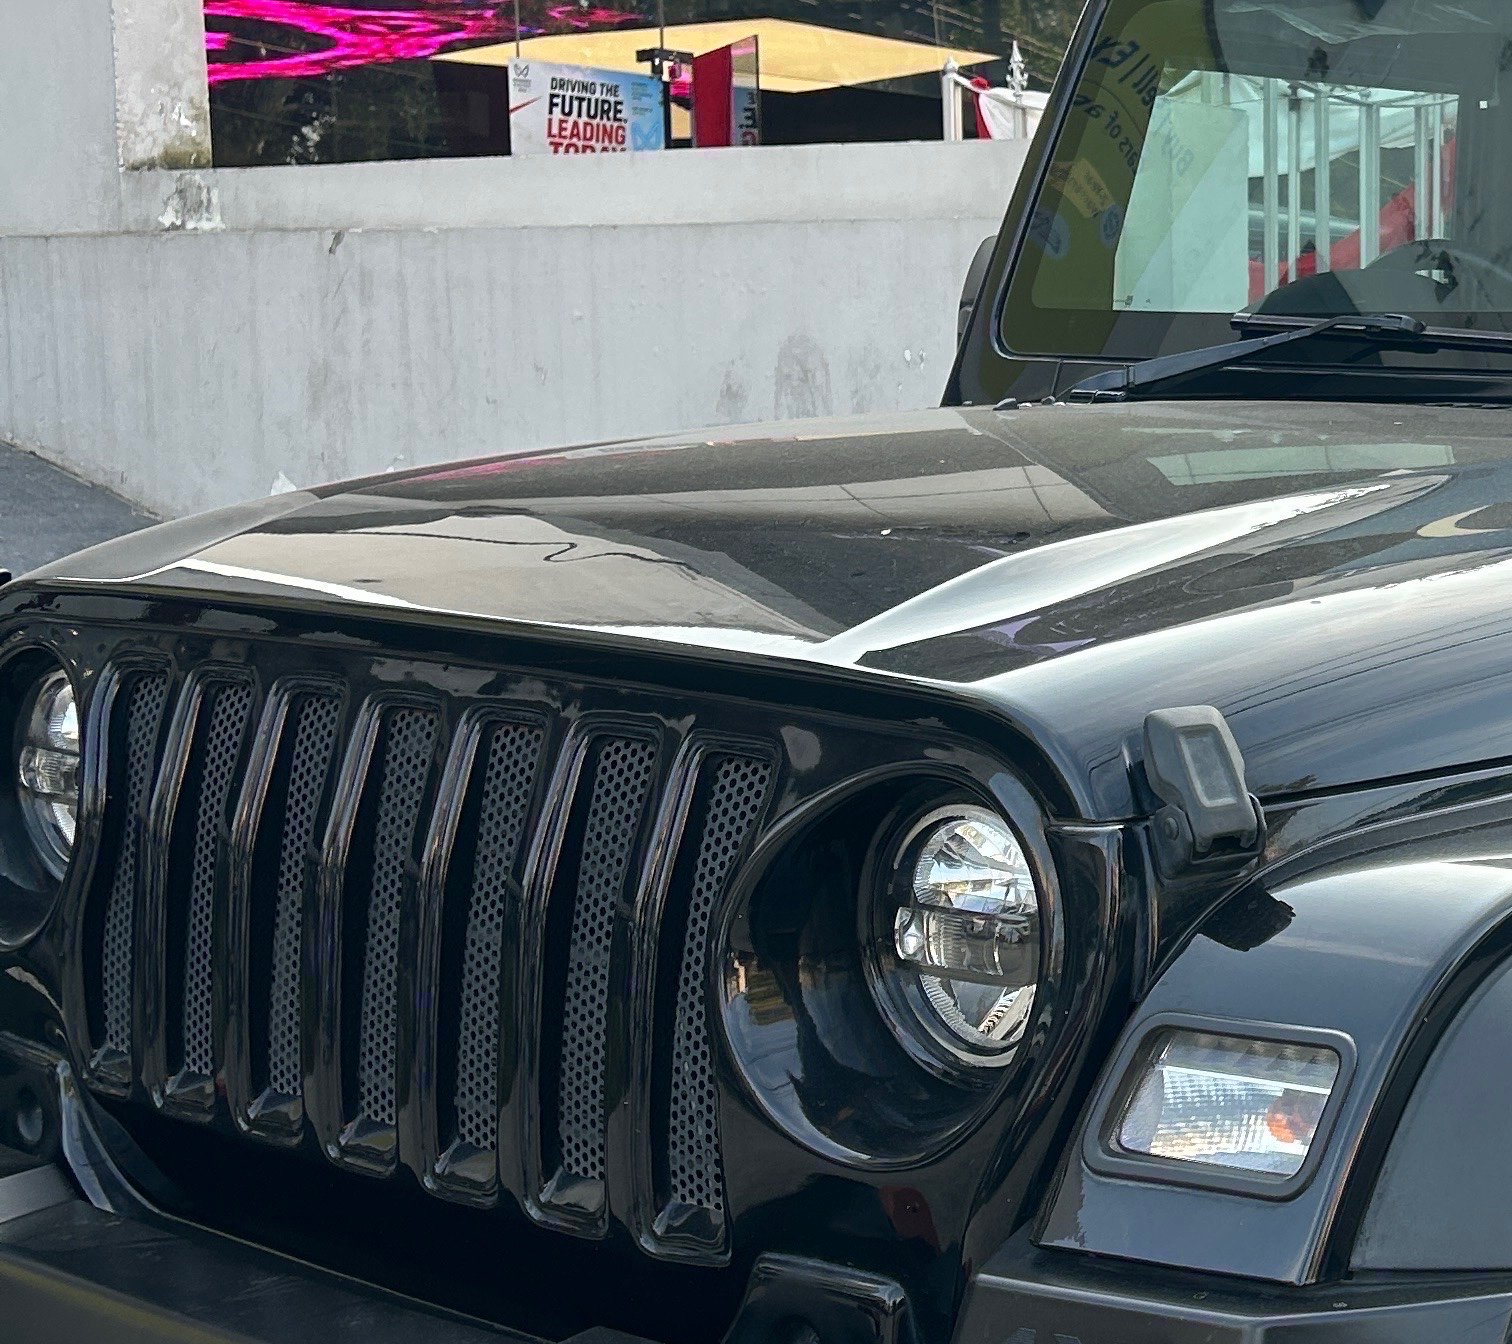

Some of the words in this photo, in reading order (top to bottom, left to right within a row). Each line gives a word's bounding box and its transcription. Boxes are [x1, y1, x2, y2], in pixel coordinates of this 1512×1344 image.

[550, 77, 597, 95] DRIVING
[600, 82, 620, 98] THE
[548, 93, 628, 124] FUTURE.
[547, 118, 626, 145] LEADING
